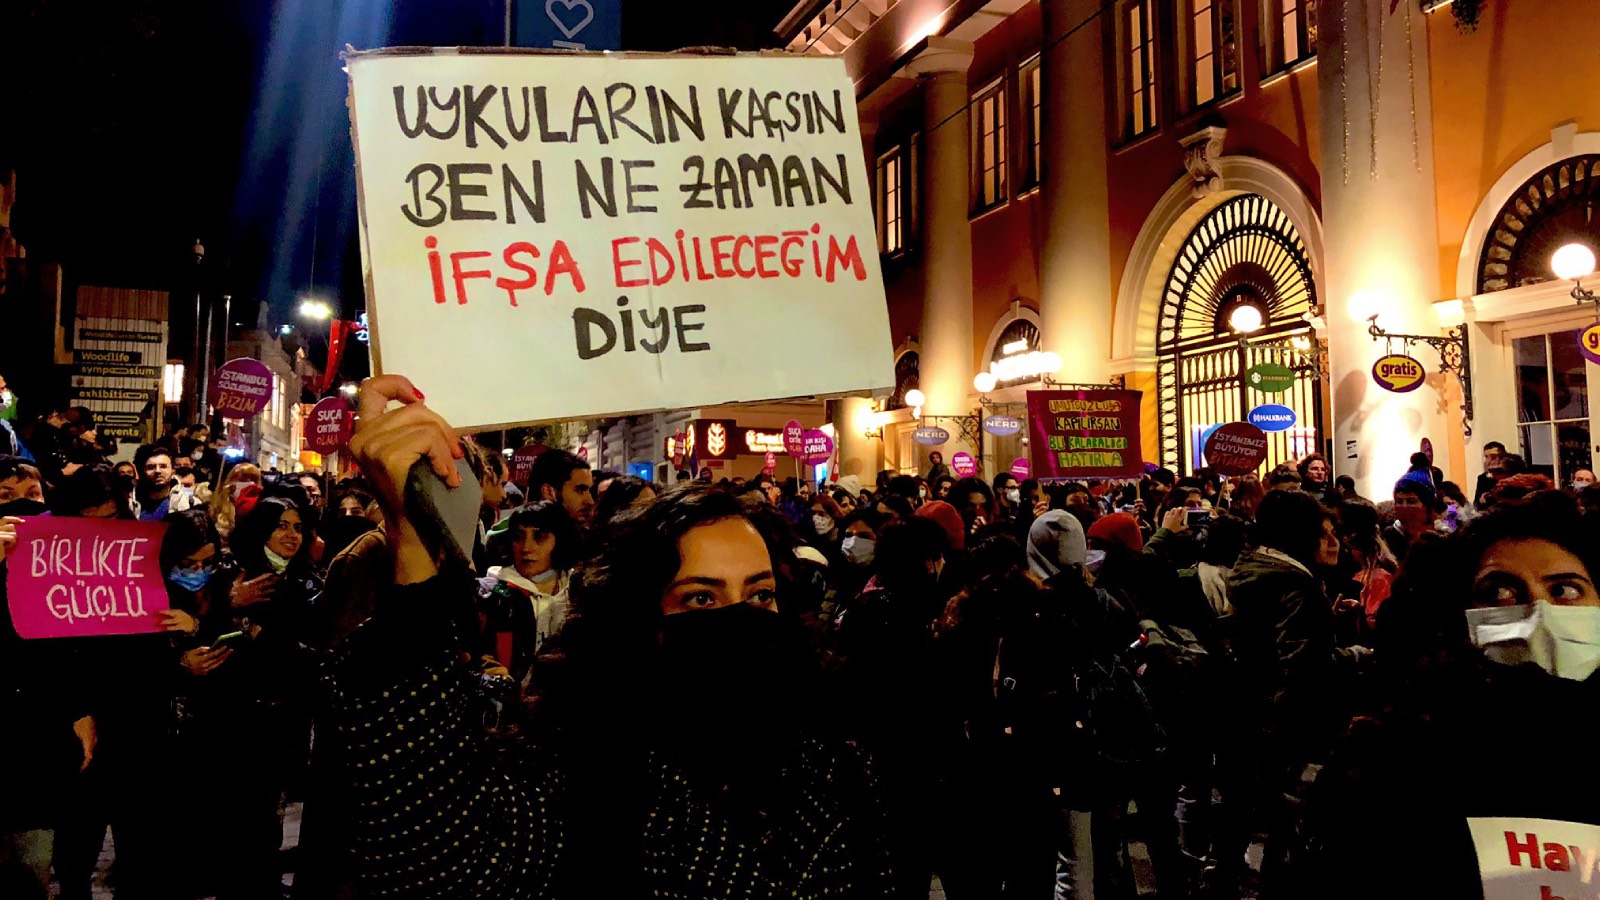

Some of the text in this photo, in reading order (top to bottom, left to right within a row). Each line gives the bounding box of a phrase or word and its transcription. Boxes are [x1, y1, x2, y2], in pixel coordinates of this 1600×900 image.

[393, 83, 847, 149] UYKULARIN KAÇSIN
[401, 153, 853, 227] BEN NE ZAMAN
[424, 224, 867, 306] İFŞA EDİLECEĞİM
[572, 296, 711, 360] DİYE
[81, 351, 130, 362] Woodlife
[81, 365, 155, 377] symposium
[1381, 361, 1417, 378] gratis
[220, 369, 269, 388] İSTANBUL
[79, 389, 149, 400] exhibition
[317, 408, 342, 425] SUÇA
[986, 420, 1018, 428] NERO
[1260, 414, 1293, 422] HALKBANK
[103, 428, 139, 437] events
[916, 431, 946, 439] NERO
[804, 444, 827, 454] DAHA
[1049, 435, 1065, 450] BU
[1059, 452, 1123, 467] HATIRLA
[31, 535, 149, 578] BİRLİKTE
[46, 579, 148, 625] GÜÇLÜ
